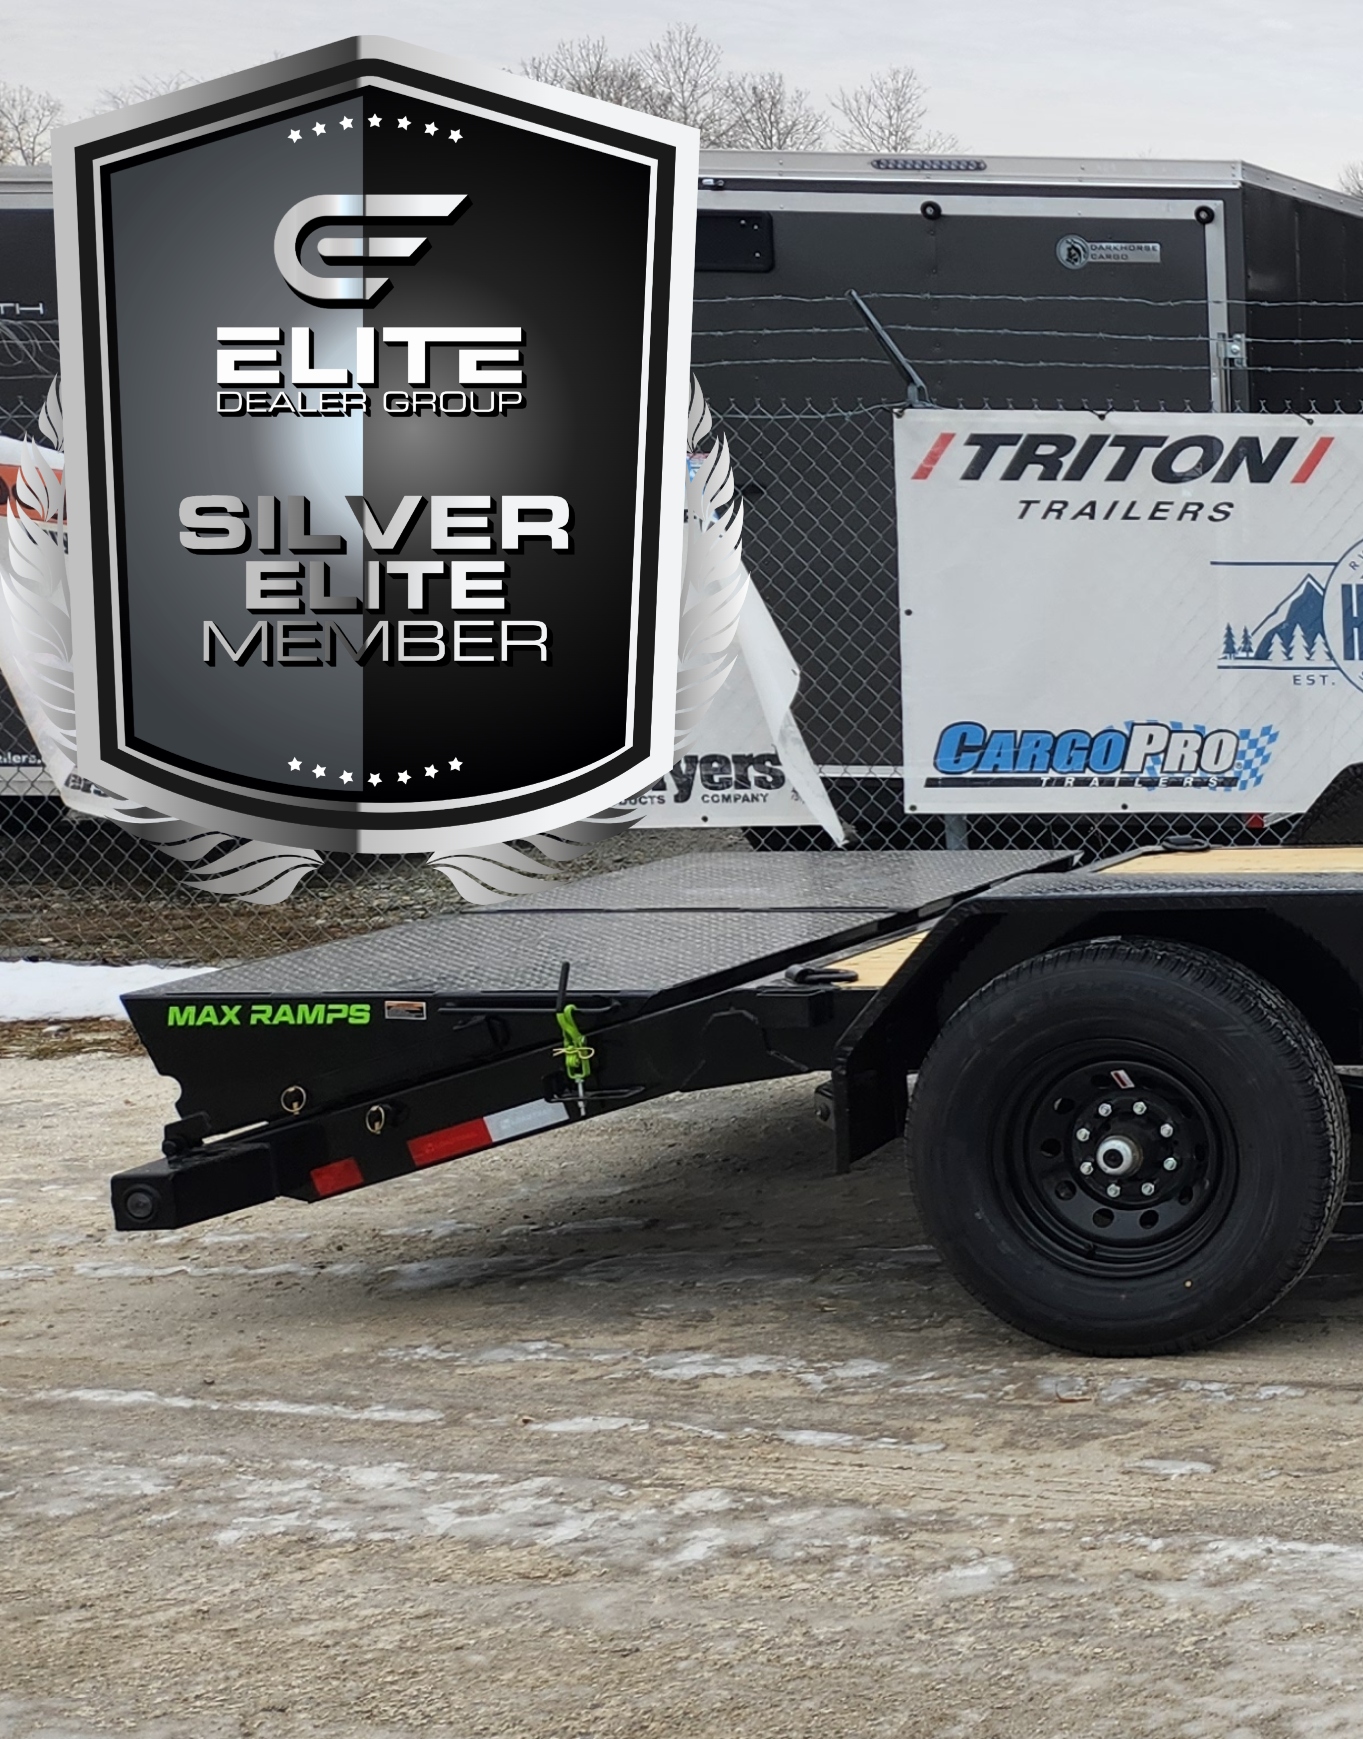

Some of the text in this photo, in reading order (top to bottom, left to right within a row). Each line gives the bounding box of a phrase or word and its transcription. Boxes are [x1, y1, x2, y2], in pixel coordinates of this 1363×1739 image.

[1090, 244, 1158, 252] DARKHORSE
[960, 433, 1299, 484] TRITON
[1017, 500, 1234, 523] TRAILERS
[1292, 675, 1336, 687] EST.
[1040, 776, 1219, 788] TRAILERS
[701, 793, 769, 804] COMPANY
[168, 1004, 241, 1026] MAX
[250, 1003, 371, 1026] RAMPS
